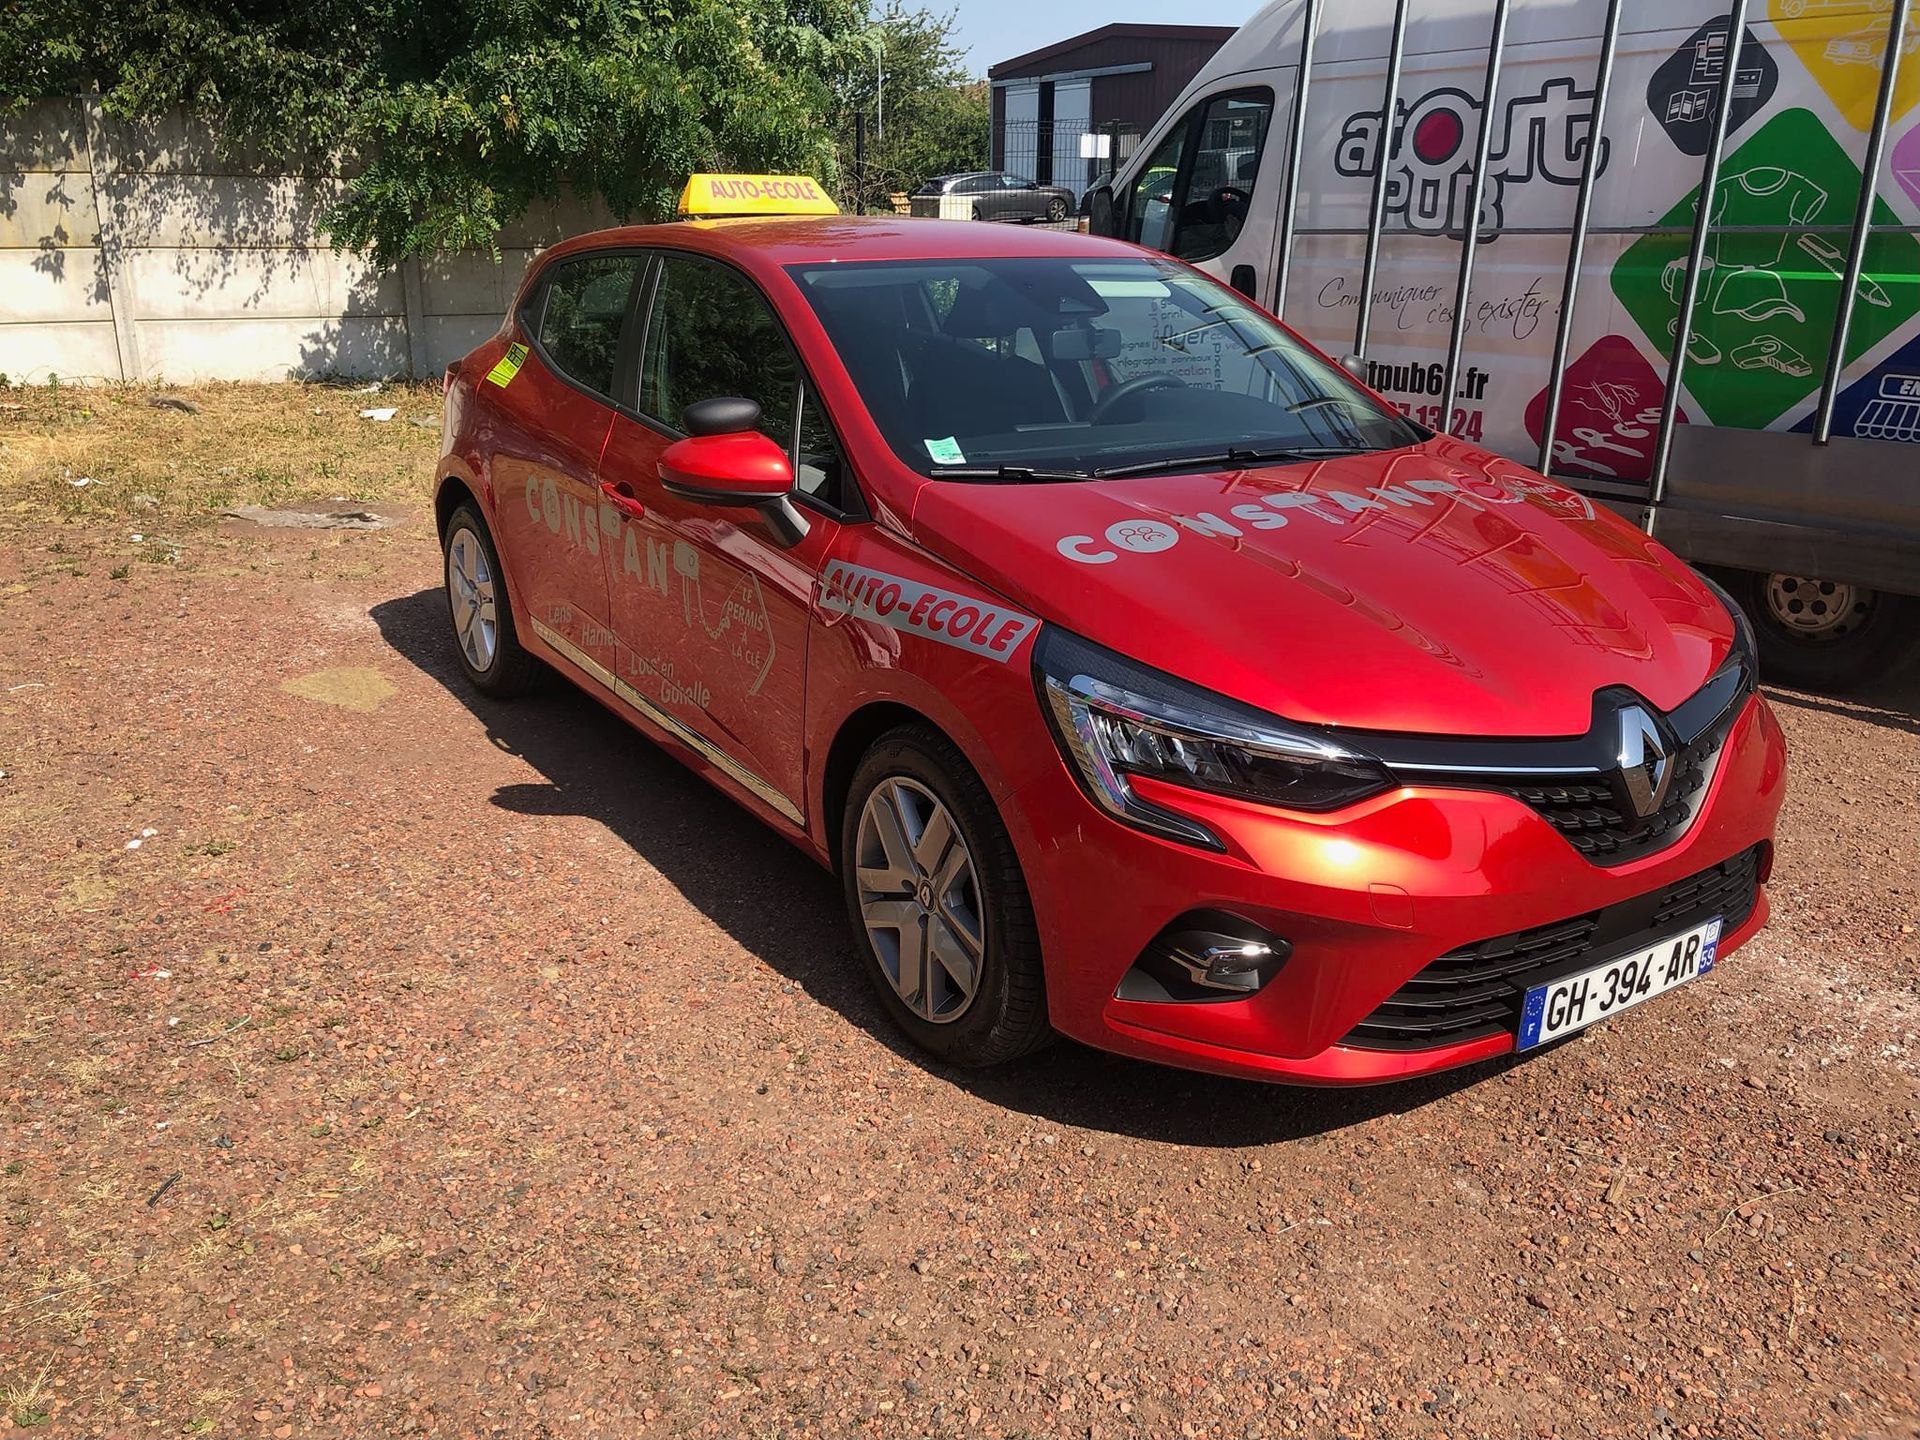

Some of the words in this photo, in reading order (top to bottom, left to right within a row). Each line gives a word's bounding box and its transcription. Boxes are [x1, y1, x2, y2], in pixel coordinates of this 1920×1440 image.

[710, 180, 819, 201] AUTO-ECOLE
[1477, 277, 1549, 340] exister
[1452, 408, 1483, 442] 24
[1056, 480, 1486, 564] CONSTANT
[525, 474, 700, 628] CONSTANT
[742, 587, 753, 604] LE
[548, 604, 572, 624] Lens
[726, 601, 764, 632] PERMIS
[830, 568, 1025, 651] AUTO-ECOLE
[731, 643, 742, 658] LA
[661, 663, 675, 679] en
[1700, 946, 1715, 969] 59
[1546, 934, 1700, 1032] GH-394-AR
[1527, 1022, 1536, 1037] F
